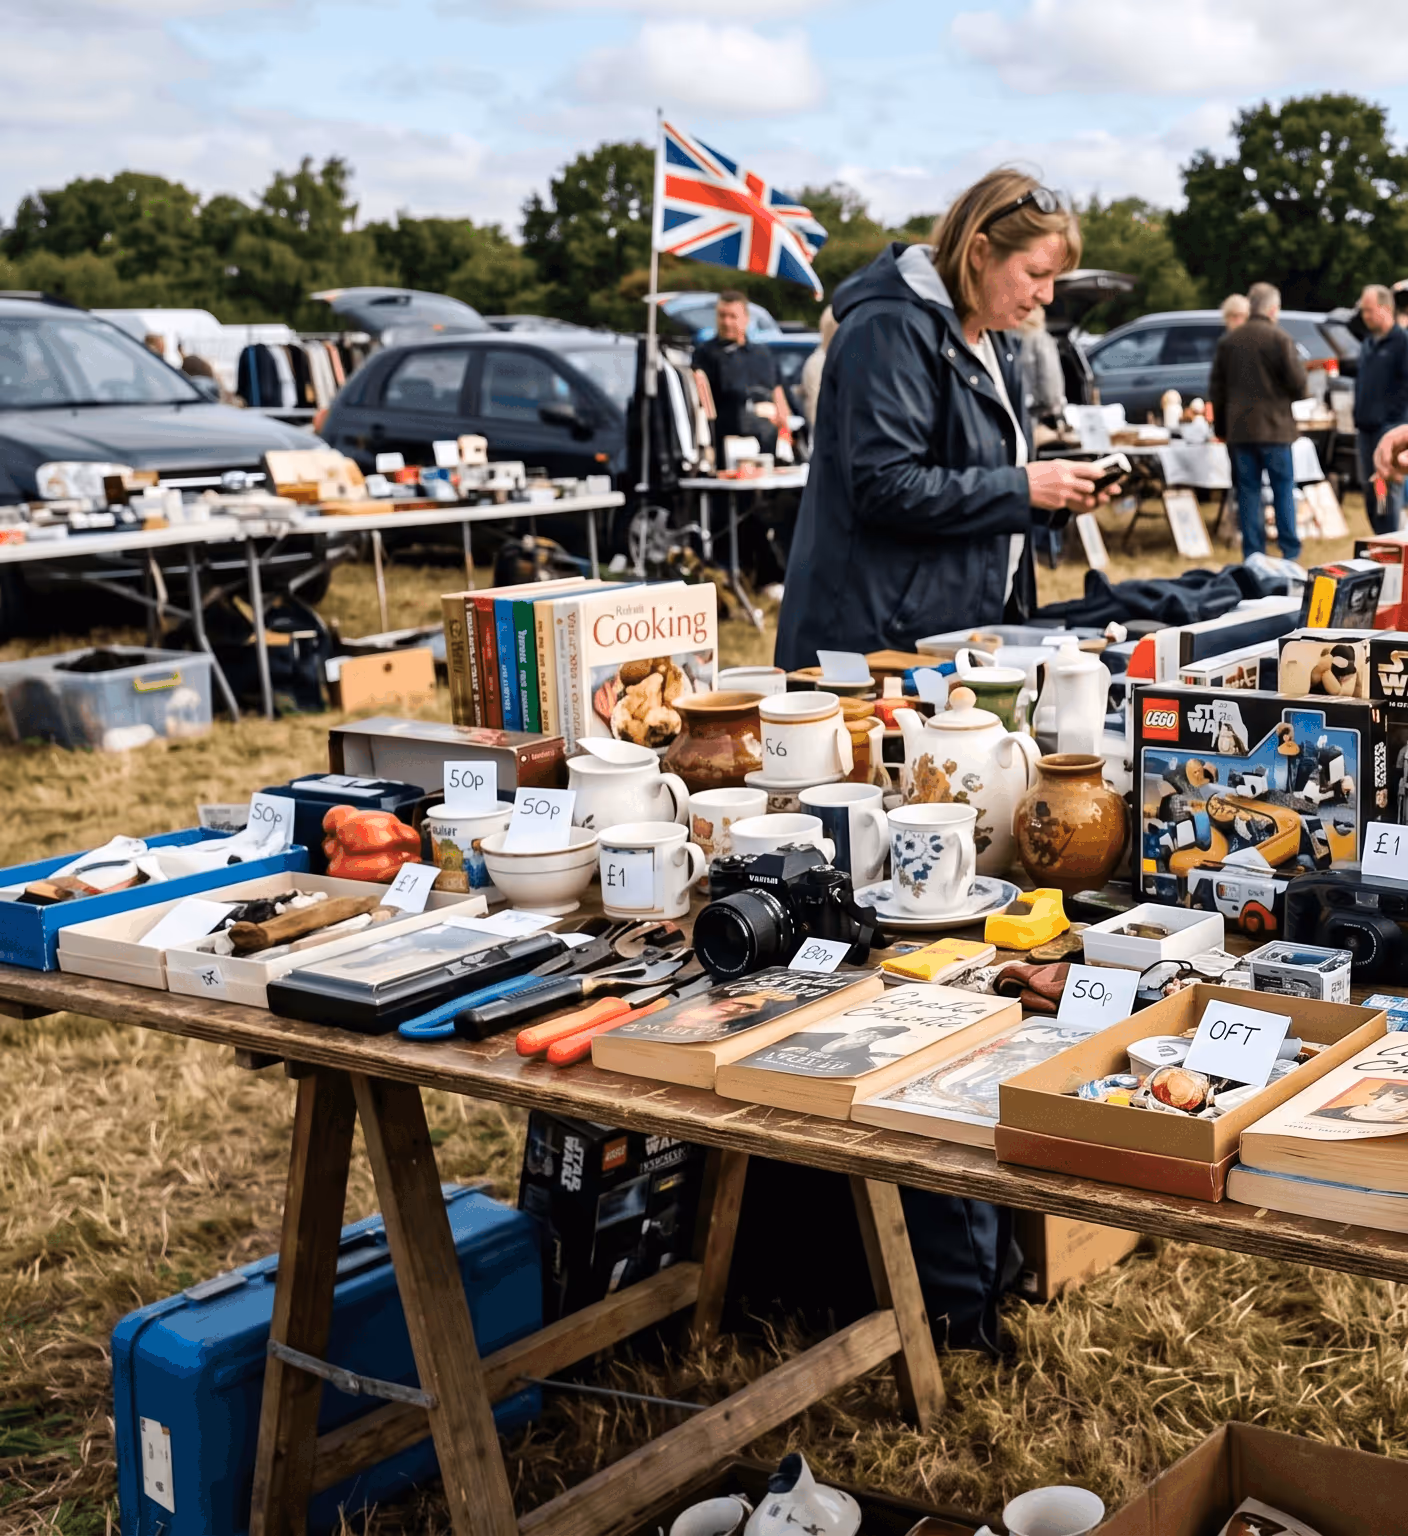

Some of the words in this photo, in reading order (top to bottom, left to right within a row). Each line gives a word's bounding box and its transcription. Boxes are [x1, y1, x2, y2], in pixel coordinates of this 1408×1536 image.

[593, 606, 708, 648] Cooking
[1144, 710, 1177, 729] LEGO
[449, 769, 485, 791] 50p
[520, 797, 561, 820] 50p
[1372, 832, 1401, 856] £1
[395, 874, 419, 894] £1
[606, 864, 626, 888] £1
[1072, 979, 1113, 1007] 50p
[1209, 1020, 1261, 1045] OFT
